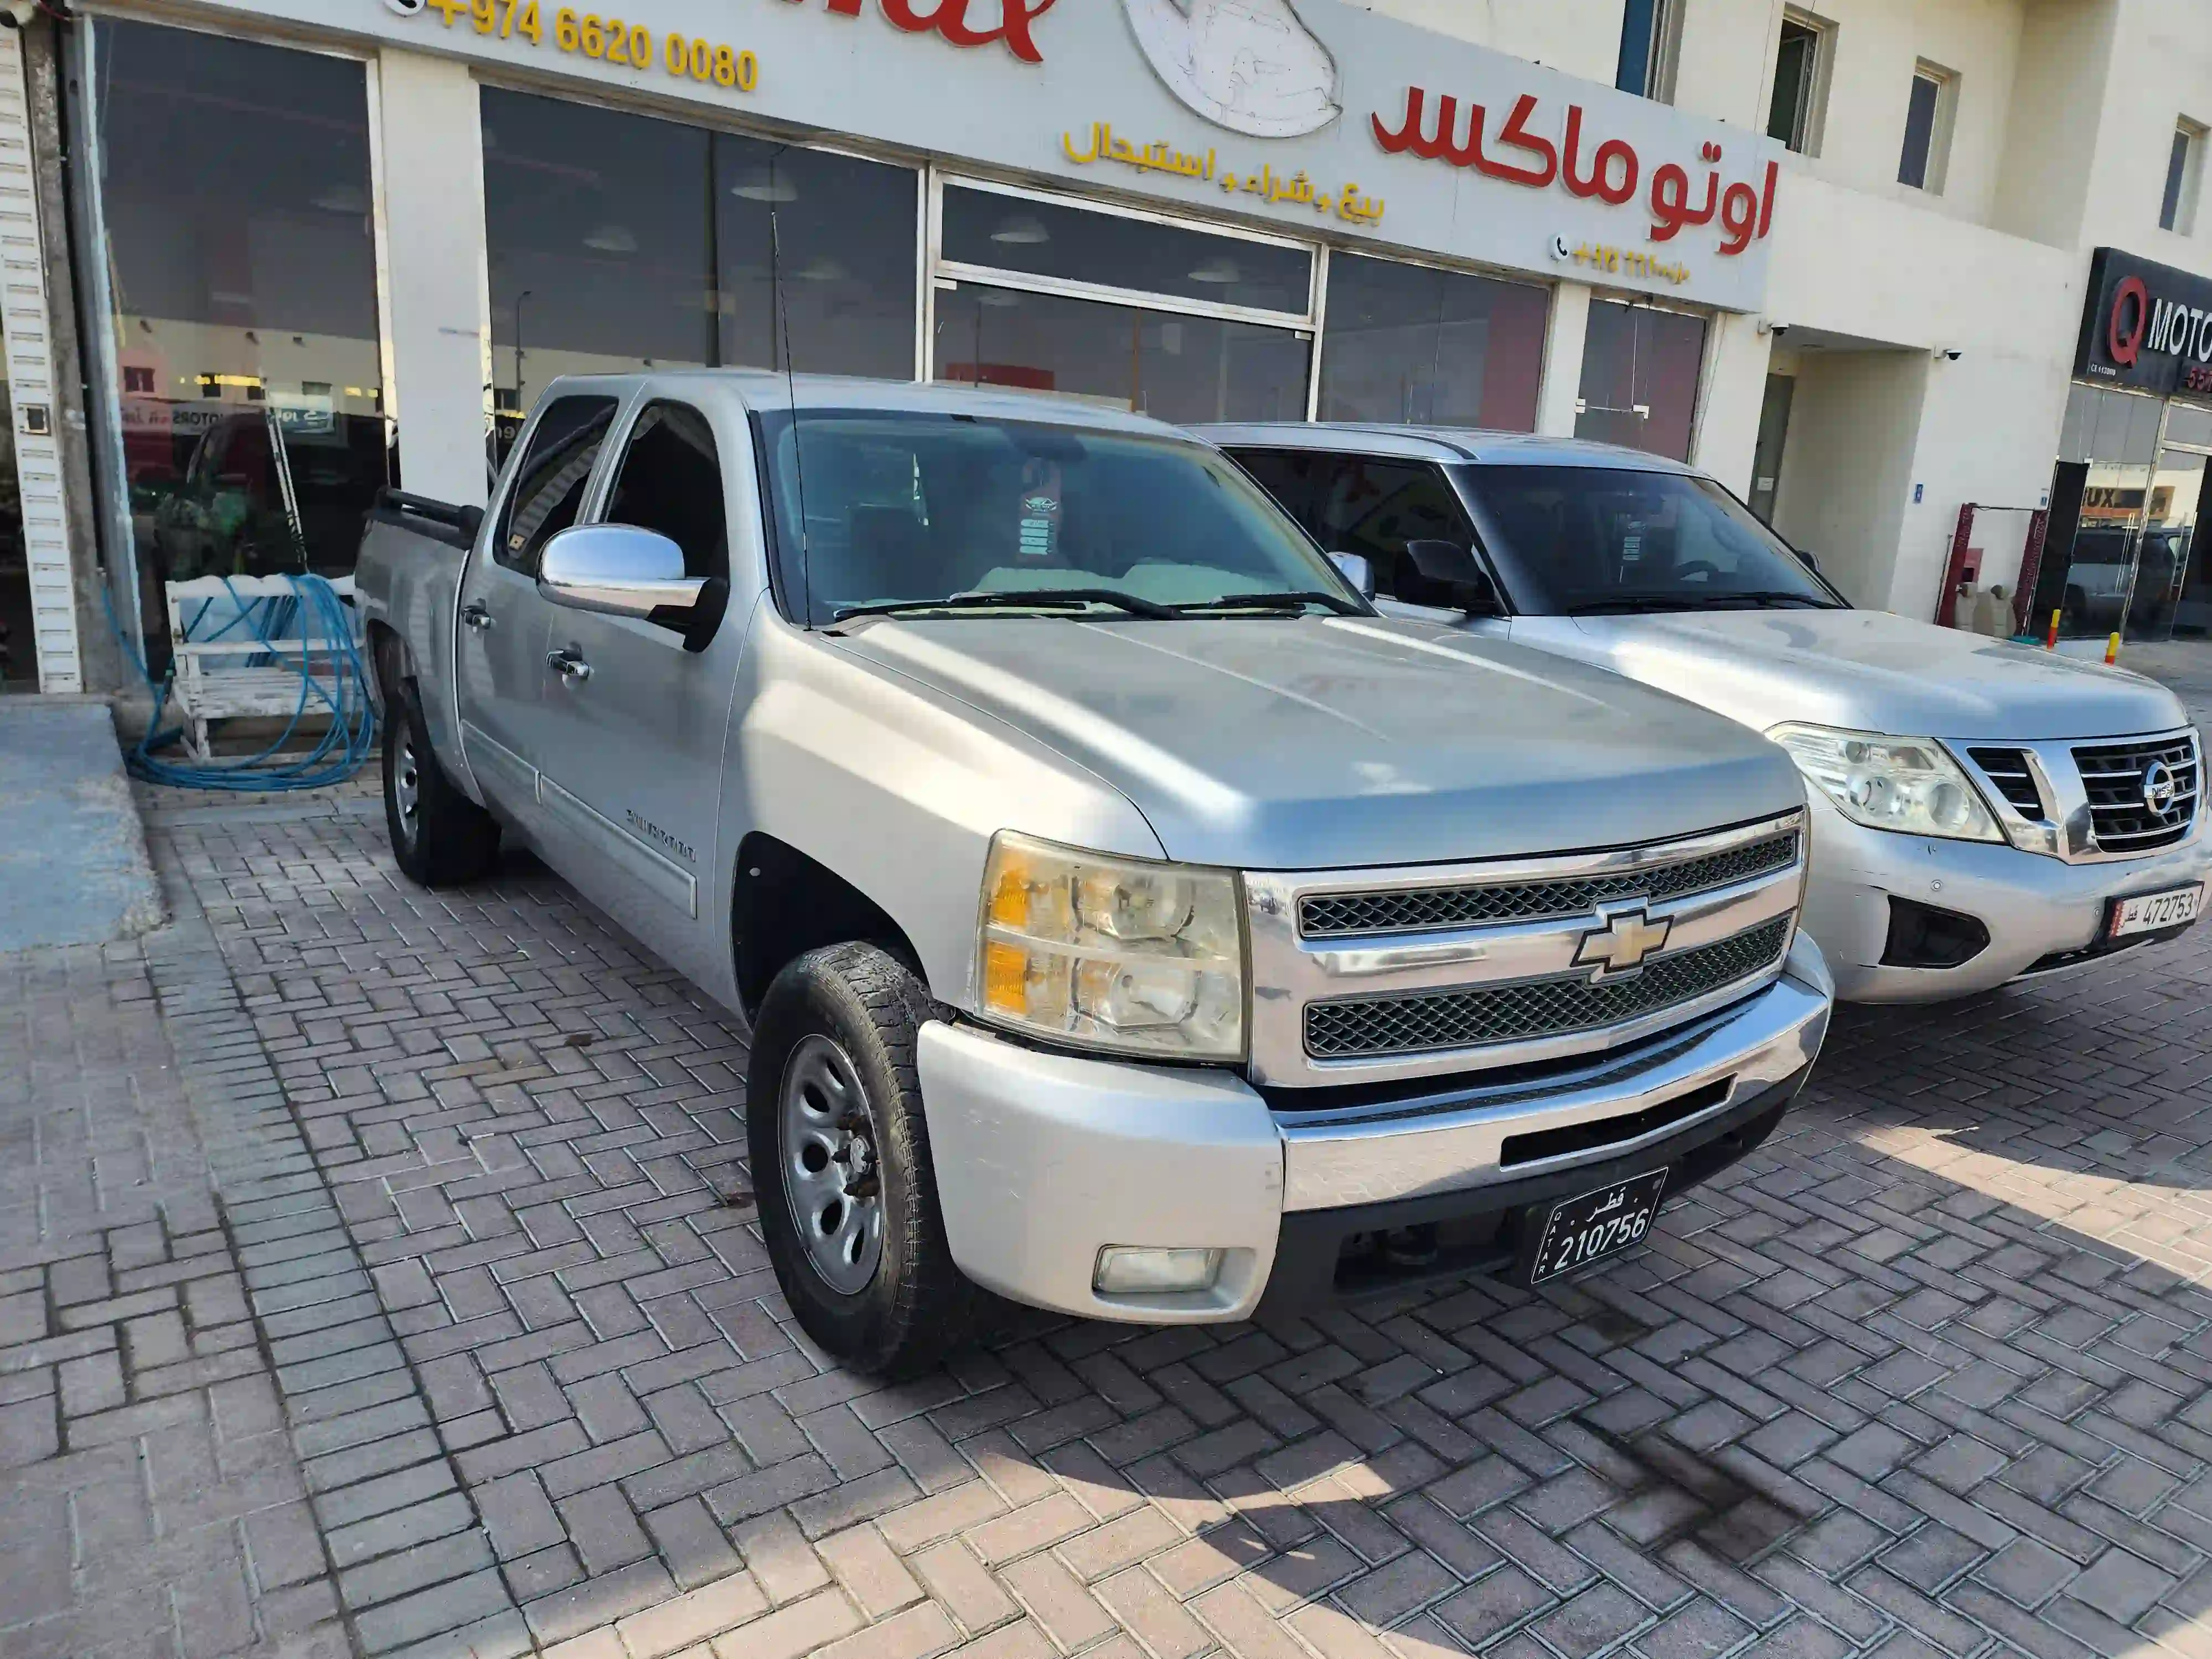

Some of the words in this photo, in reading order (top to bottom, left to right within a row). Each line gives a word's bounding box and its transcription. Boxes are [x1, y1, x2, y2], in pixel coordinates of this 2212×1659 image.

[556, 7, 652, 68] 6620
[666, 32, 758, 91] 0080
[1371, 86, 1639, 205] ماكس
[1649, 141, 1779, 255] اوتو
[2109, 276, 2147, 368] Q
[2143, 892, 2194, 926] 472753
[1554, 1208, 1649, 1270] 210756
[1585, 1186, 1626, 1222] قطر
